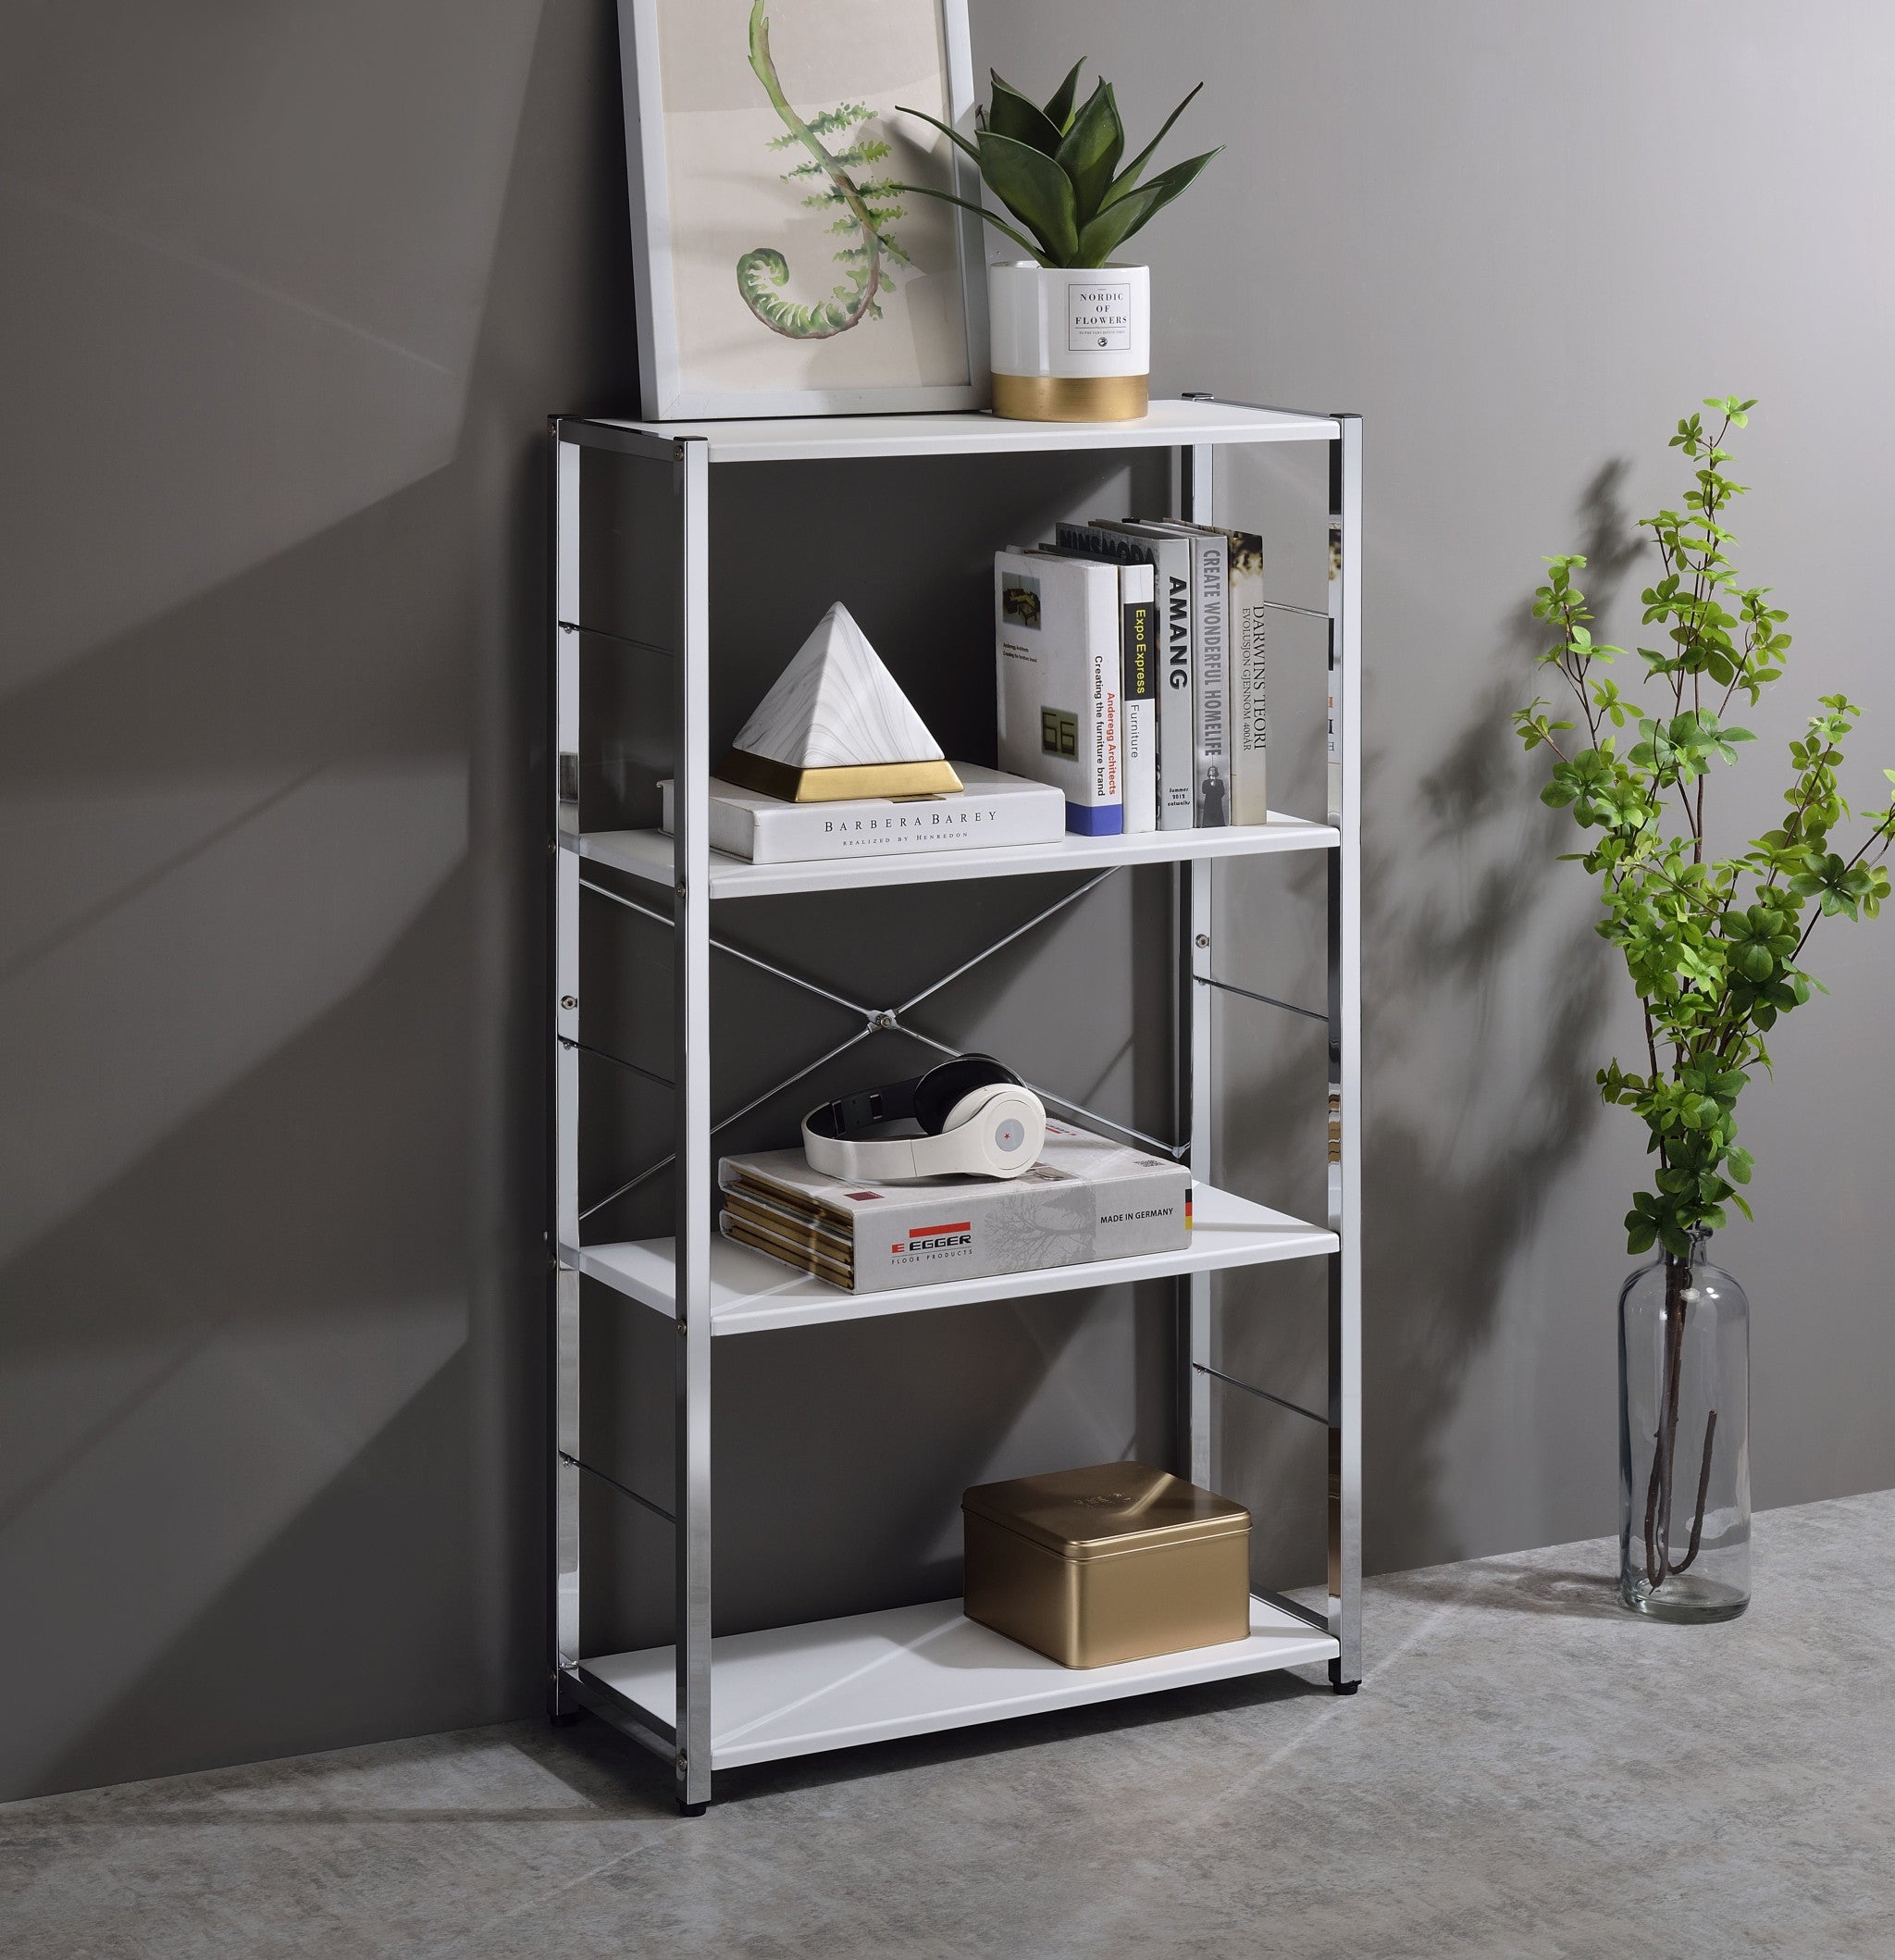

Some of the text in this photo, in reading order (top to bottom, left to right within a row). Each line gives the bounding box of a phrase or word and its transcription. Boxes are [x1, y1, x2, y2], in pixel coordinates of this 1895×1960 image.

[1080, 292, 1124, 302] NORDIC
[1096, 304, 1110, 313] OF
[1075, 316, 1127, 325] FLOWERS
[1169, 576, 1188, 690] AMANG
[1242, 607, 1251, 666] EVOLUSJON
[1134, 609, 1146, 694] Expo Express
[1203, 549, 1222, 757] CREATE WONDERFUL HOMELIFE
[1094, 655, 1104, 699] Creating
[1253, 604, 1267, 750] DARWINS TEORI
[1096, 701, 1104, 718] the
[1242, 670, 1251, 720] GJENNOM
[1106, 692, 1117, 795] Anderegg Architects
[1131, 704, 1140, 759] Furniture
[1096, 767, 1106, 797] brand
[824, 811, 997, 833] BARBERA BAREY
[843, 837, 890, 846] REALIZED
[916, 832, 969, 841] HENREDON
[1100, 1207, 1174, 1224] MADE IN GERMANY
[891, 1248, 972, 1265] FLOOR PRODUCTS
[909, 1234, 972, 1251] EGGER
